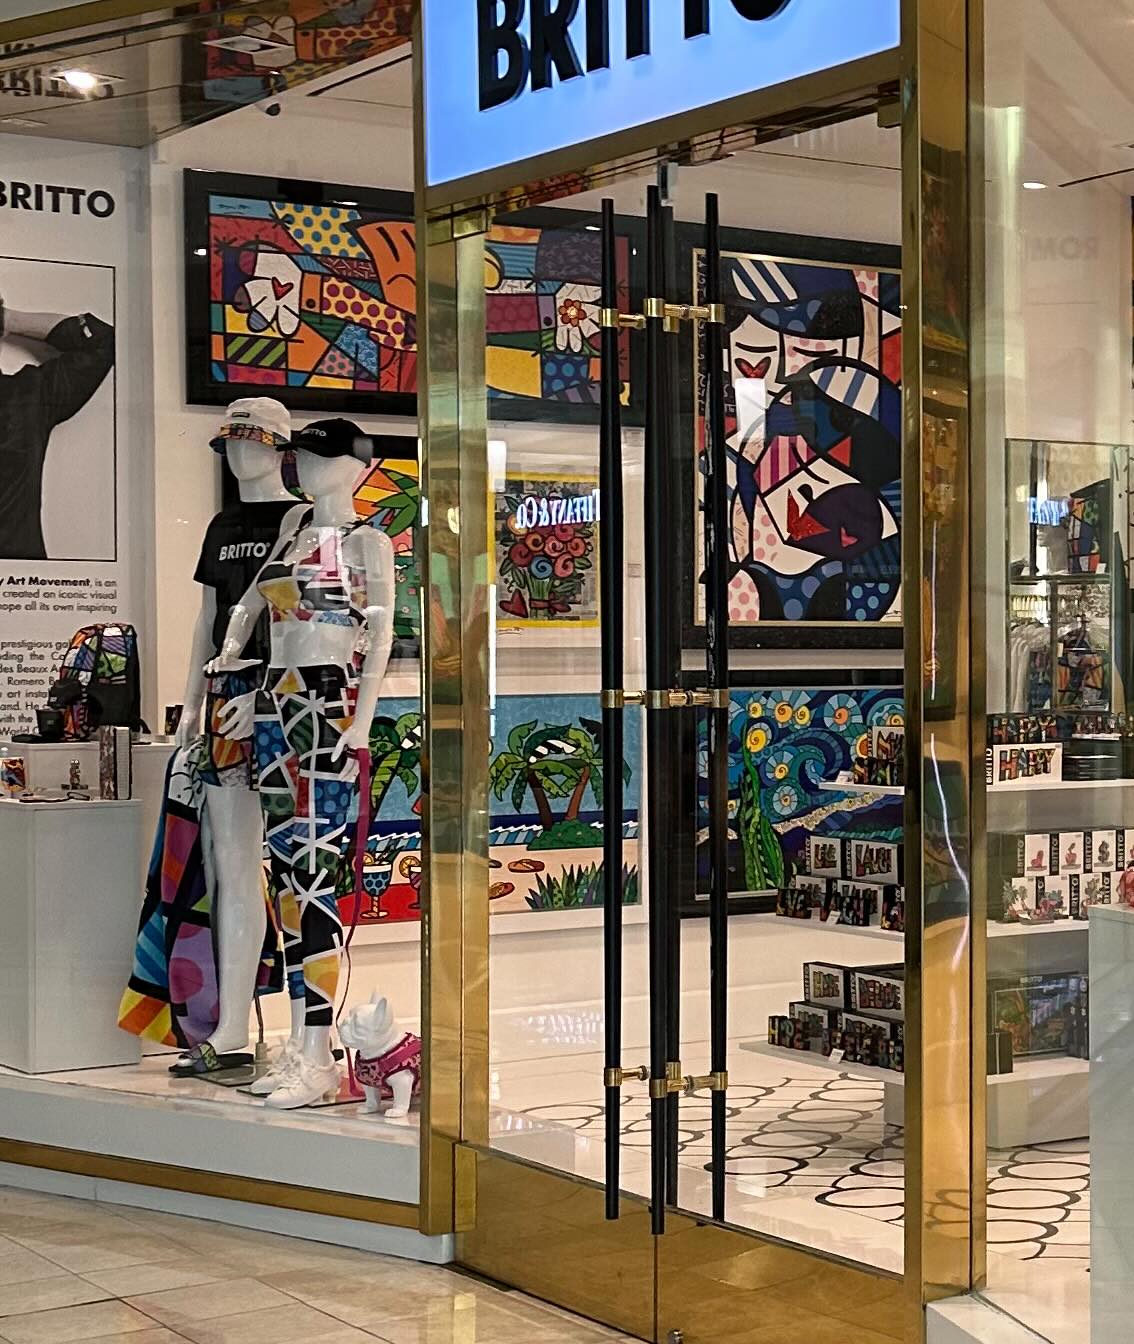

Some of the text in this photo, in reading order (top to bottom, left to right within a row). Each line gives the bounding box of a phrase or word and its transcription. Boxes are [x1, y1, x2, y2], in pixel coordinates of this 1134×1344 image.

[7, 576, 26, 586] Art
[95, 578, 103, 587] is
[3, 589, 117, 600] created an iconic visual
[25, 601, 37, 611] all
[40, 602, 50, 611] its
[53, 603, 74, 611] own
[77, 602, 118, 614] inspiring
[1, 639, 53, 650] prestigious
[30, 651, 45, 661] the
[16, 664, 48, 673] Beaux
[7, 676, 45, 686] Romero
[7, 689, 21, 699] art
[18, 713, 33, 723] the
